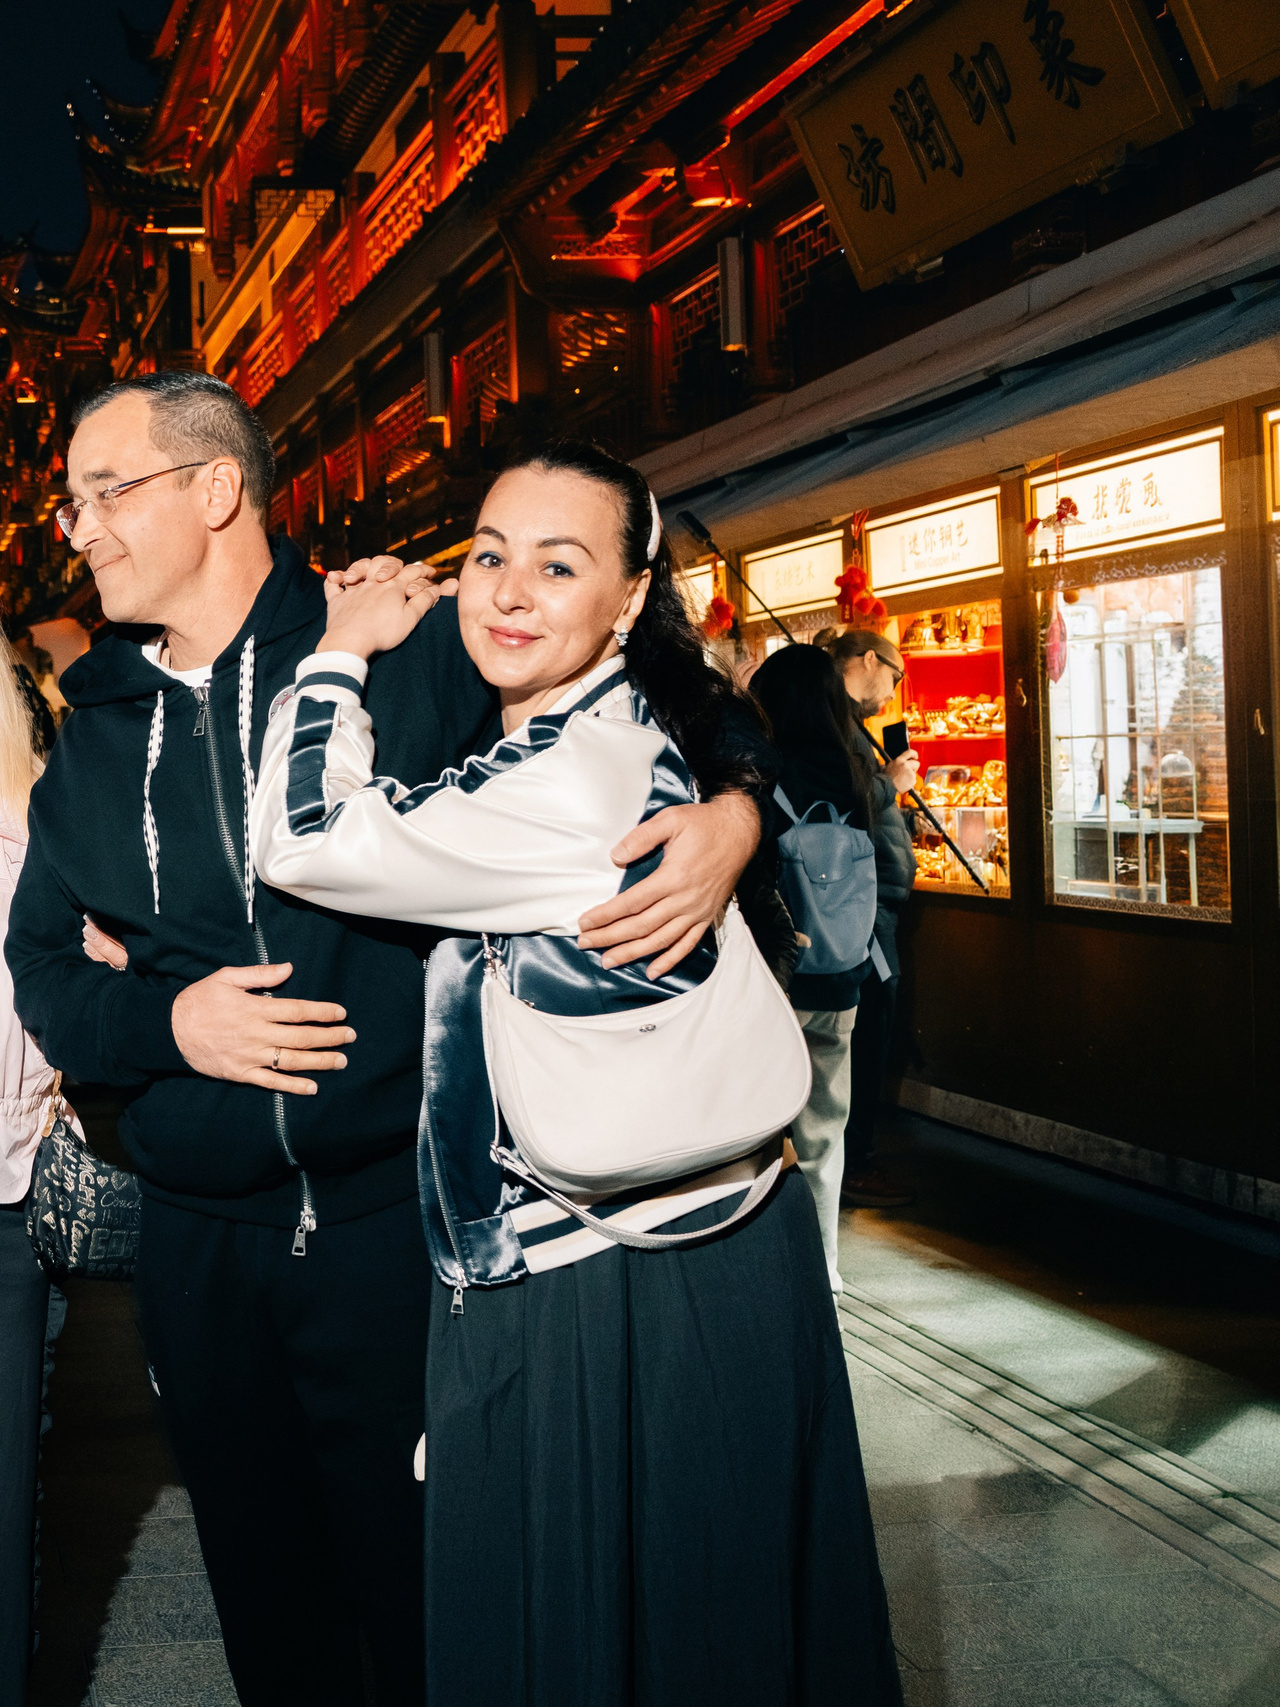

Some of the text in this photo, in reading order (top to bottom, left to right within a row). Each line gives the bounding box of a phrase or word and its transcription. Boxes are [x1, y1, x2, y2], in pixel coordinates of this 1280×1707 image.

[908, 520, 969, 556] 迷你铜艺
[914, 552, 961, 571] Mini Copper Art
